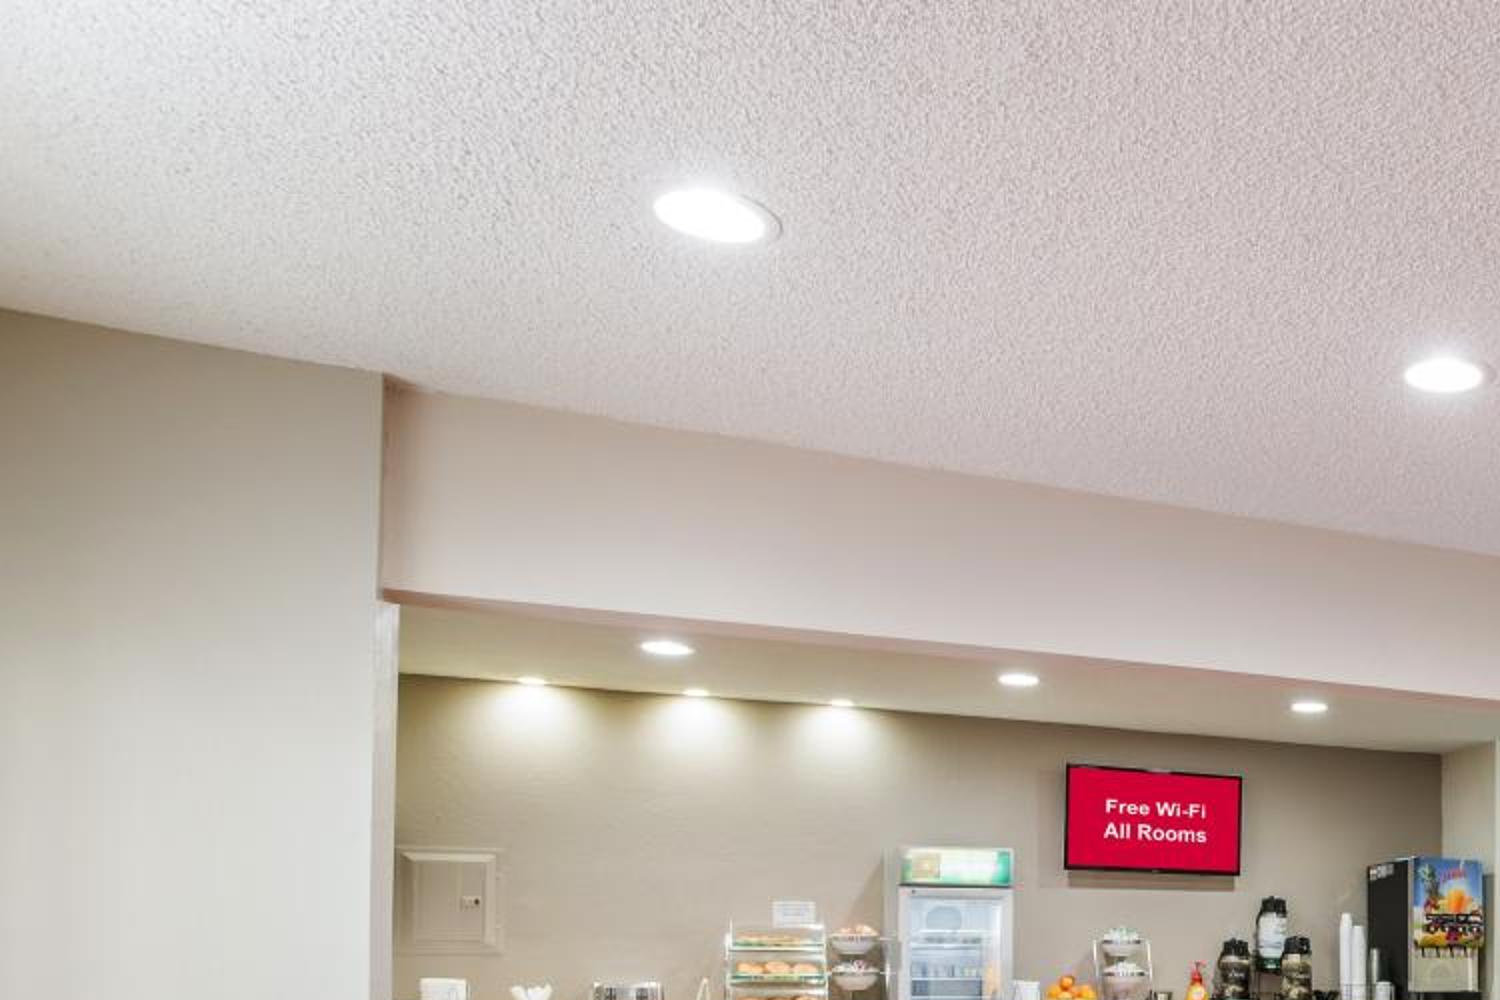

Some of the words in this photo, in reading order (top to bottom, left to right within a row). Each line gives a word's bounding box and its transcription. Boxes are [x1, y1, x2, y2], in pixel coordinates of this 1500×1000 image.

[1105, 799, 1150, 816] Free
[1155, 801, 1206, 819] Wi-Fi
[1103, 822, 1131, 839] All
[1137, 824, 1207, 843] Rooms
